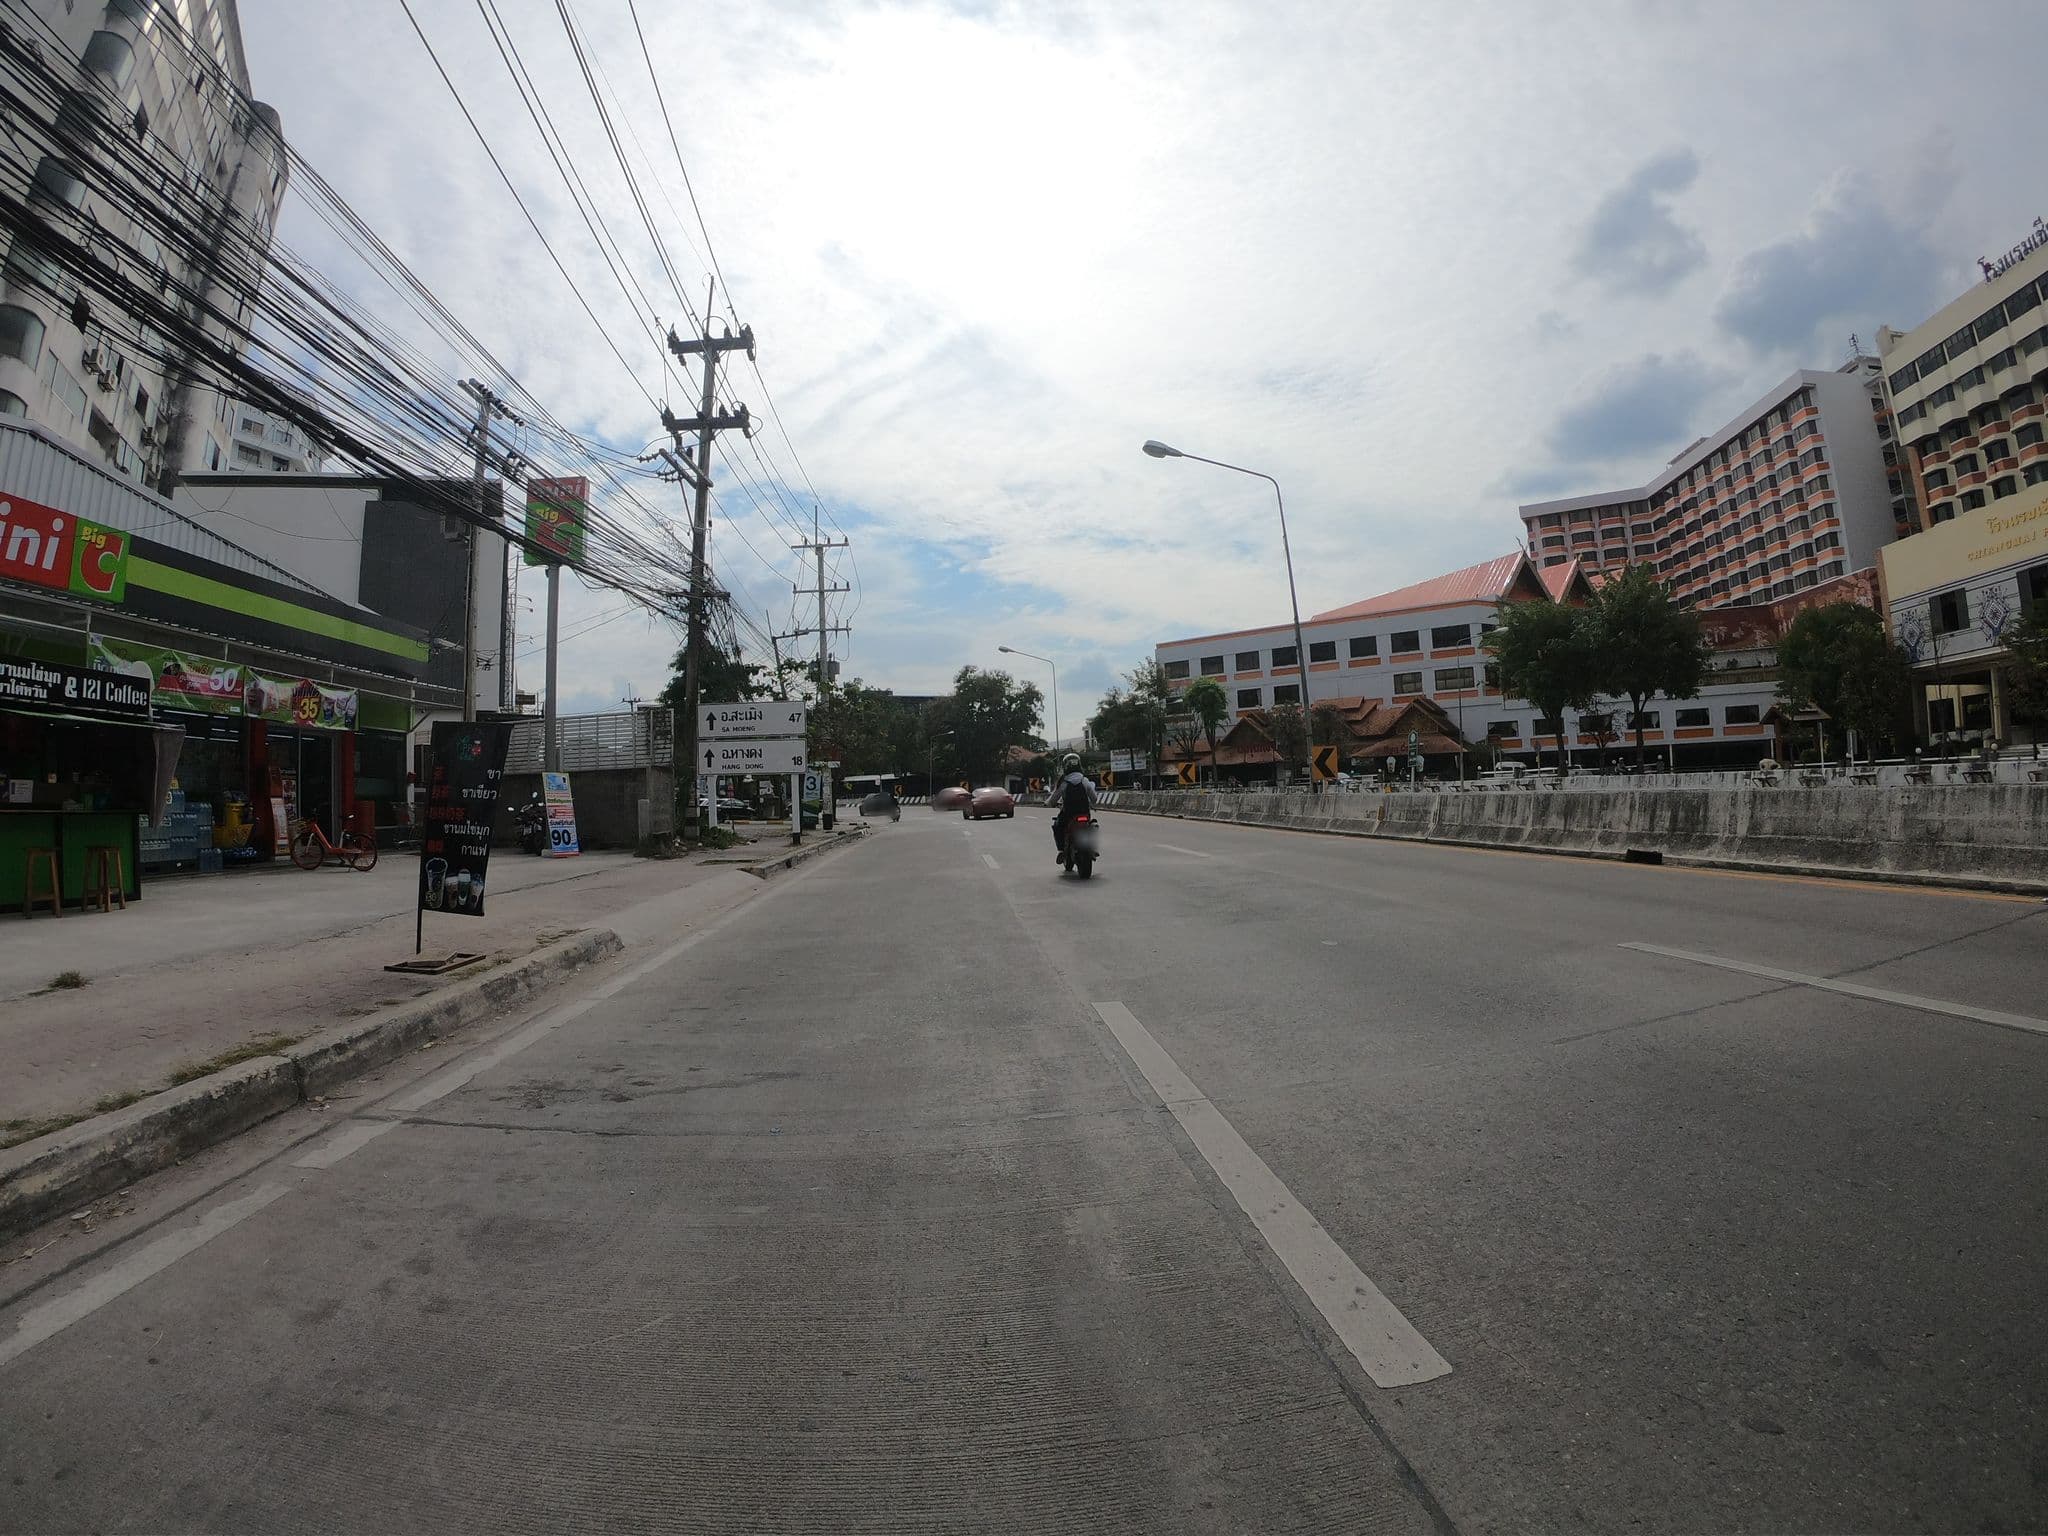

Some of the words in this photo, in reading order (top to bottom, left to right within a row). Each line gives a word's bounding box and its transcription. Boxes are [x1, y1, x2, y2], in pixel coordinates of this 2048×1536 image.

[81, 526, 107, 549] Big
[81, 533, 125, 593] C
[208, 666, 239, 693] 50
[64, 676, 78, 698] &
[82, 677, 102, 700] 121
[105, 681, 148, 706] Coffee
[299, 697, 319, 720] 35
[721, 707, 762, 721] อ.สะเมิง
[788, 713, 802, 723] 47
[721, 748, 763, 760] อ.หางดง
[791, 755, 803, 766] 18
[461, 784, 499, 800] ชาเขียว
[806, 775, 817, 791] 3
[443, 820, 490, 841] ชานมไข่มุก
[551, 829, 572, 846] 90
[461, 843, 488, 856] กาแฟ
